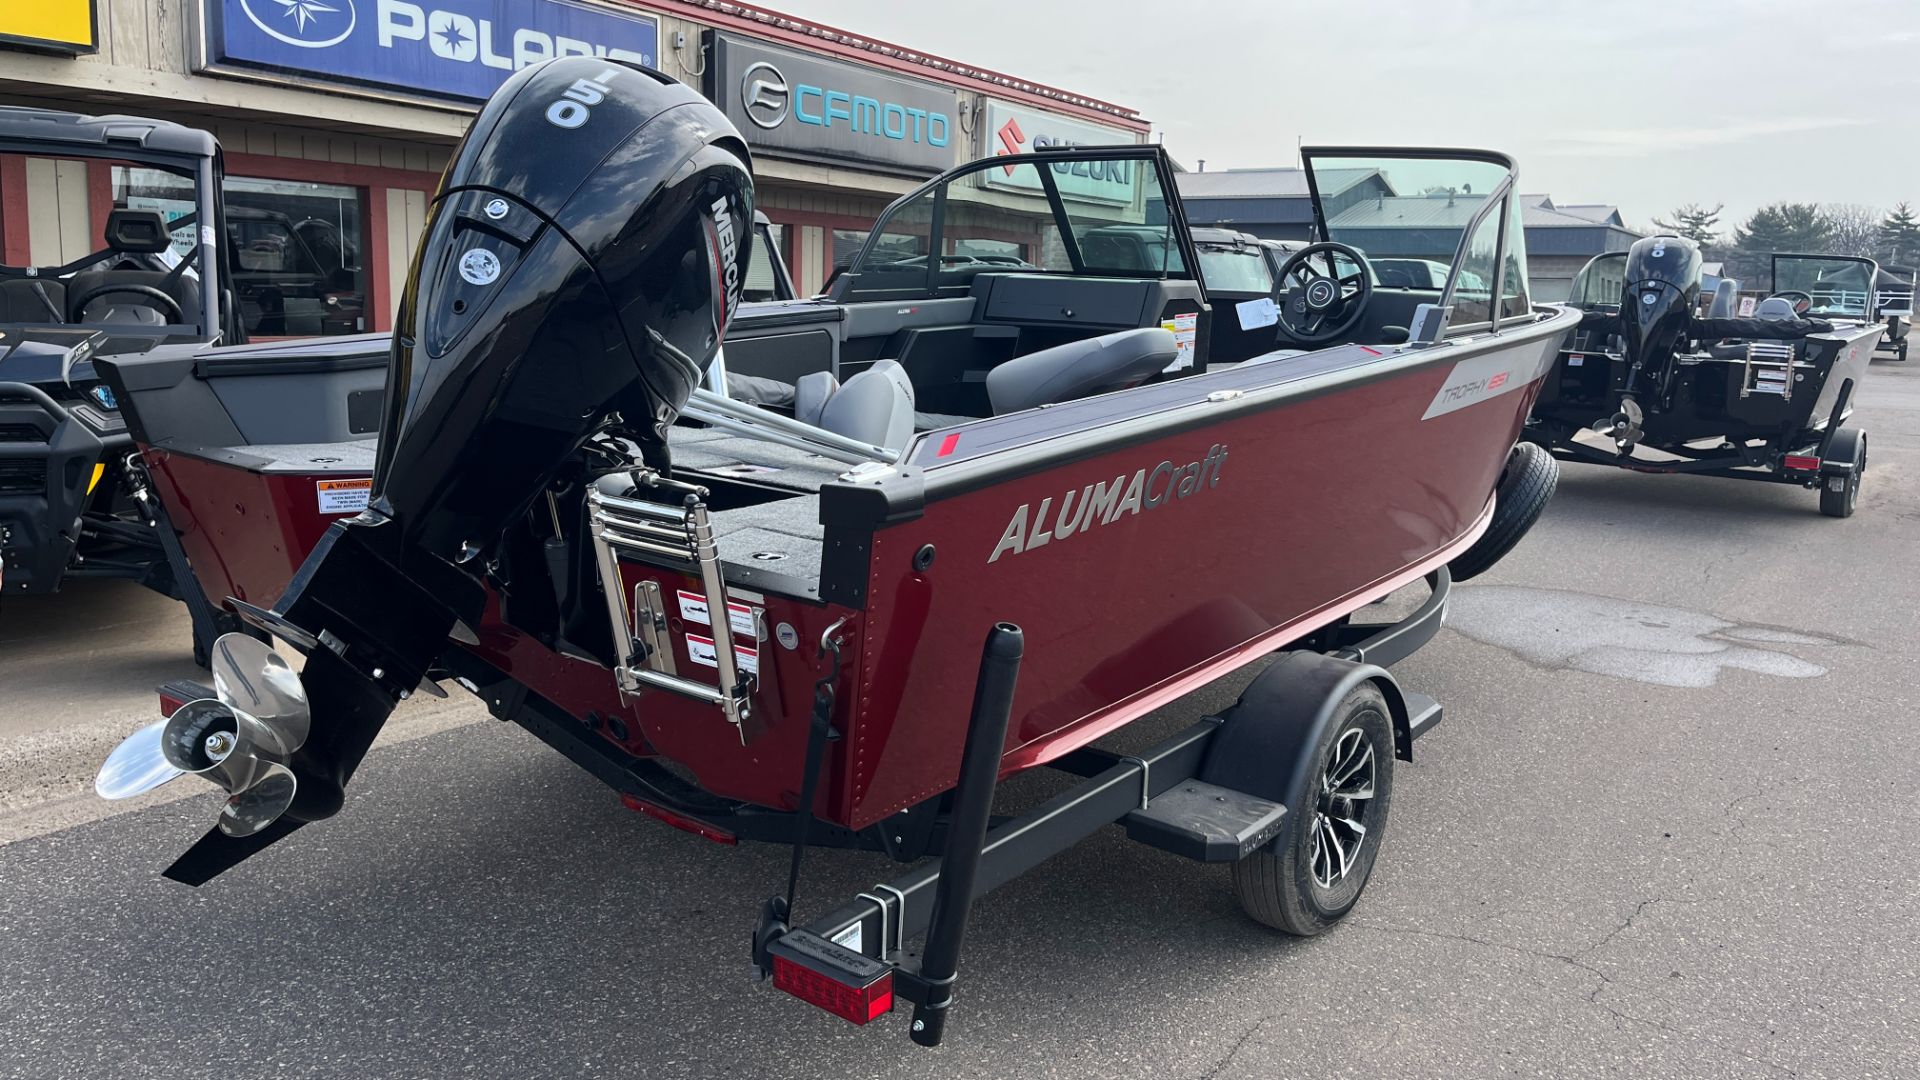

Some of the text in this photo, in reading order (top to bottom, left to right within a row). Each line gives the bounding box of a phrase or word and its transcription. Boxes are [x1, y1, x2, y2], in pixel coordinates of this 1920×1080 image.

[377, 0, 643, 72] POLA
[545, 68, 620, 129] 150
[794, 84, 949, 147] CFMOTO
[336, 481, 370, 489] WARNING
[987, 444, 1229, 564] ALUMACraft
